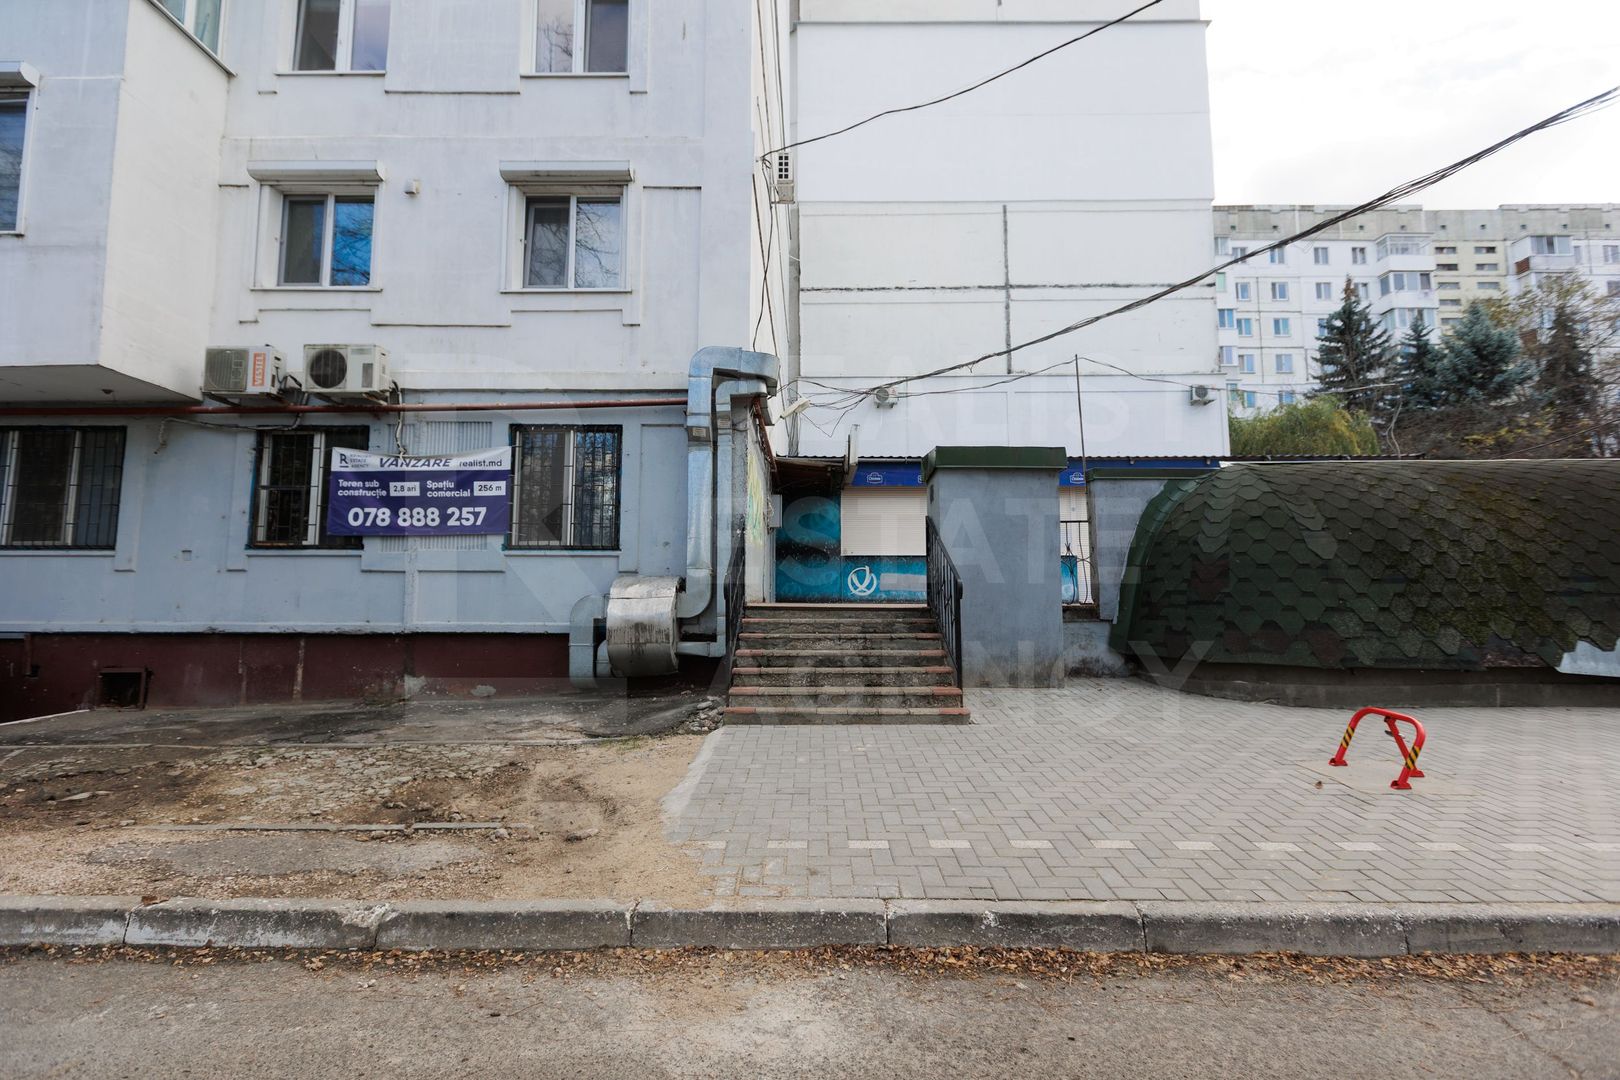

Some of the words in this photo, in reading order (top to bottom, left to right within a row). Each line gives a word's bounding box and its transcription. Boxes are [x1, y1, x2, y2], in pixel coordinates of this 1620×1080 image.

[459, 459, 503, 467] realist.md
[338, 479, 363, 488] Teren
[365, 480, 380, 488] sub
[478, 484, 494, 492] 256
[337, 488, 388, 499] construcție
[427, 489, 471, 498] comercial
[348, 507, 391, 527] 078
[397, 507, 441, 527] 888
[446, 507, 487, 526] 257
